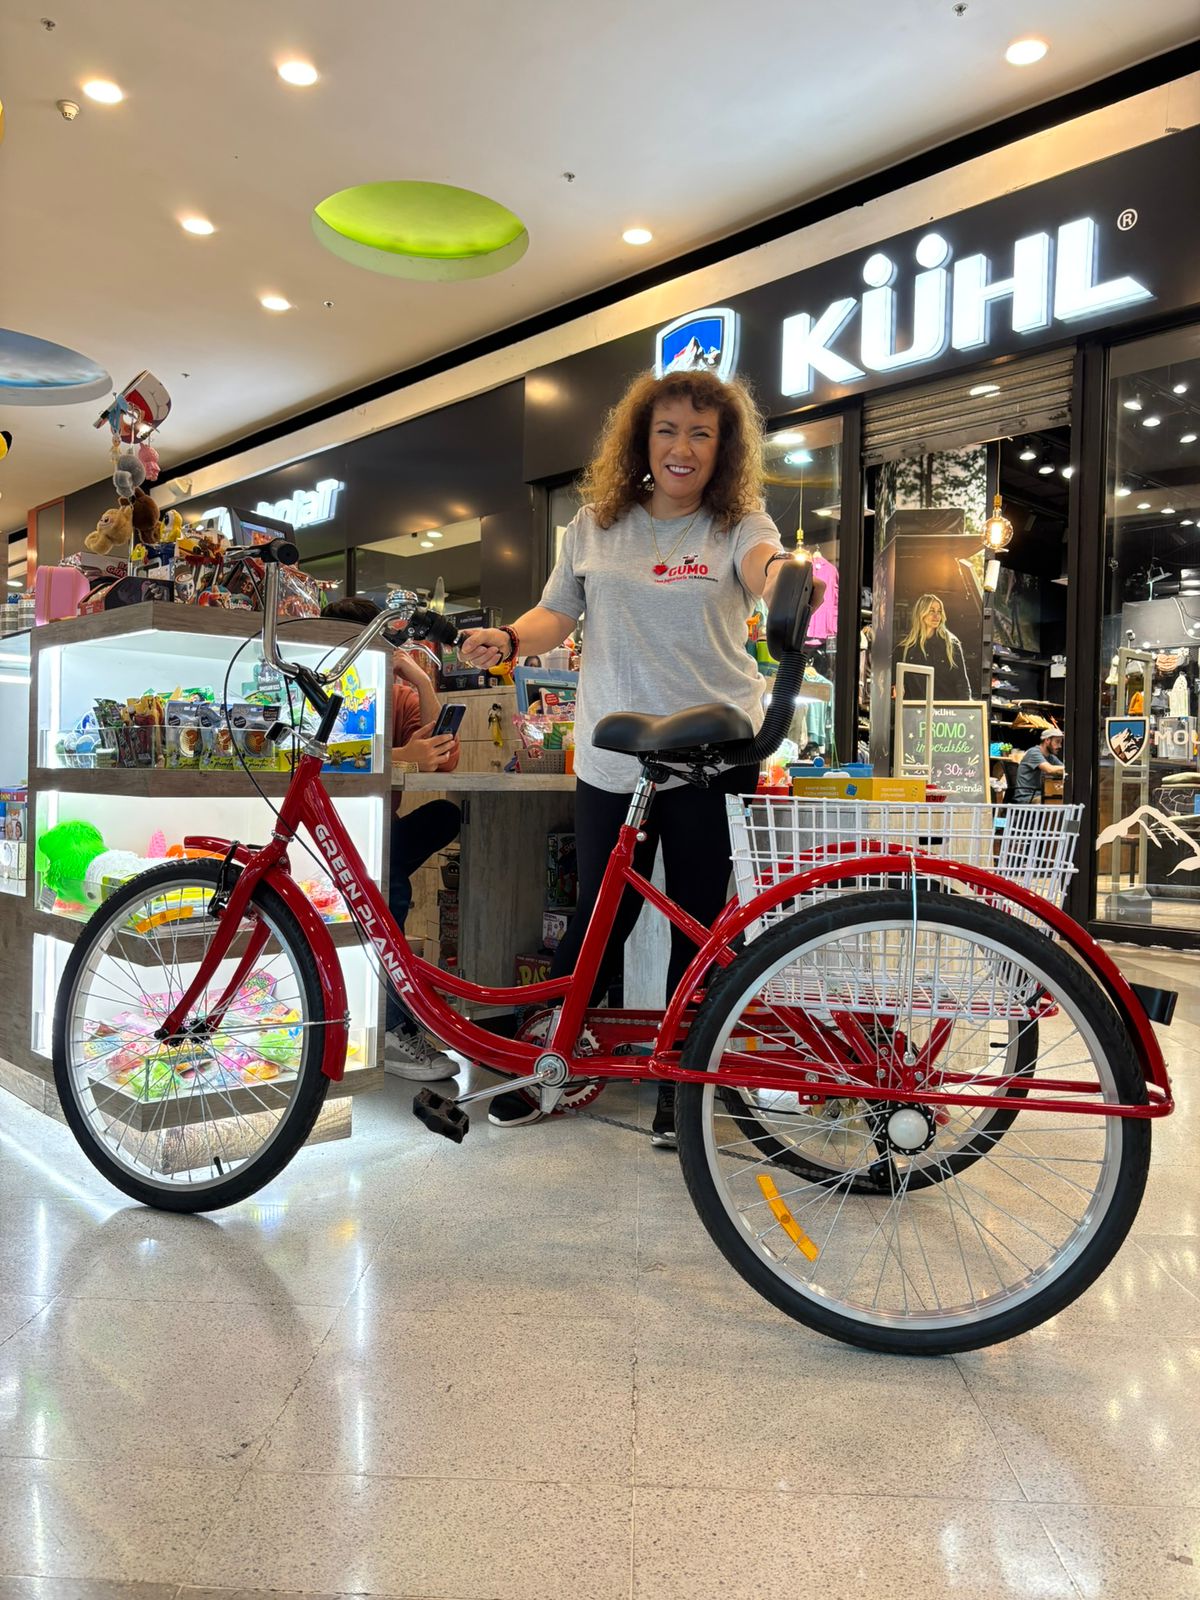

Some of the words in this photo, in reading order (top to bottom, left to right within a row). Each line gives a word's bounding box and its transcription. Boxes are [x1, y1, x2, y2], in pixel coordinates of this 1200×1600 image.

[781, 216, 1155, 398] KÜHL
[668, 563, 709, 577] GUMO
[315, 823, 362, 901] GREEN
[357, 903, 415, 995] PLANET
